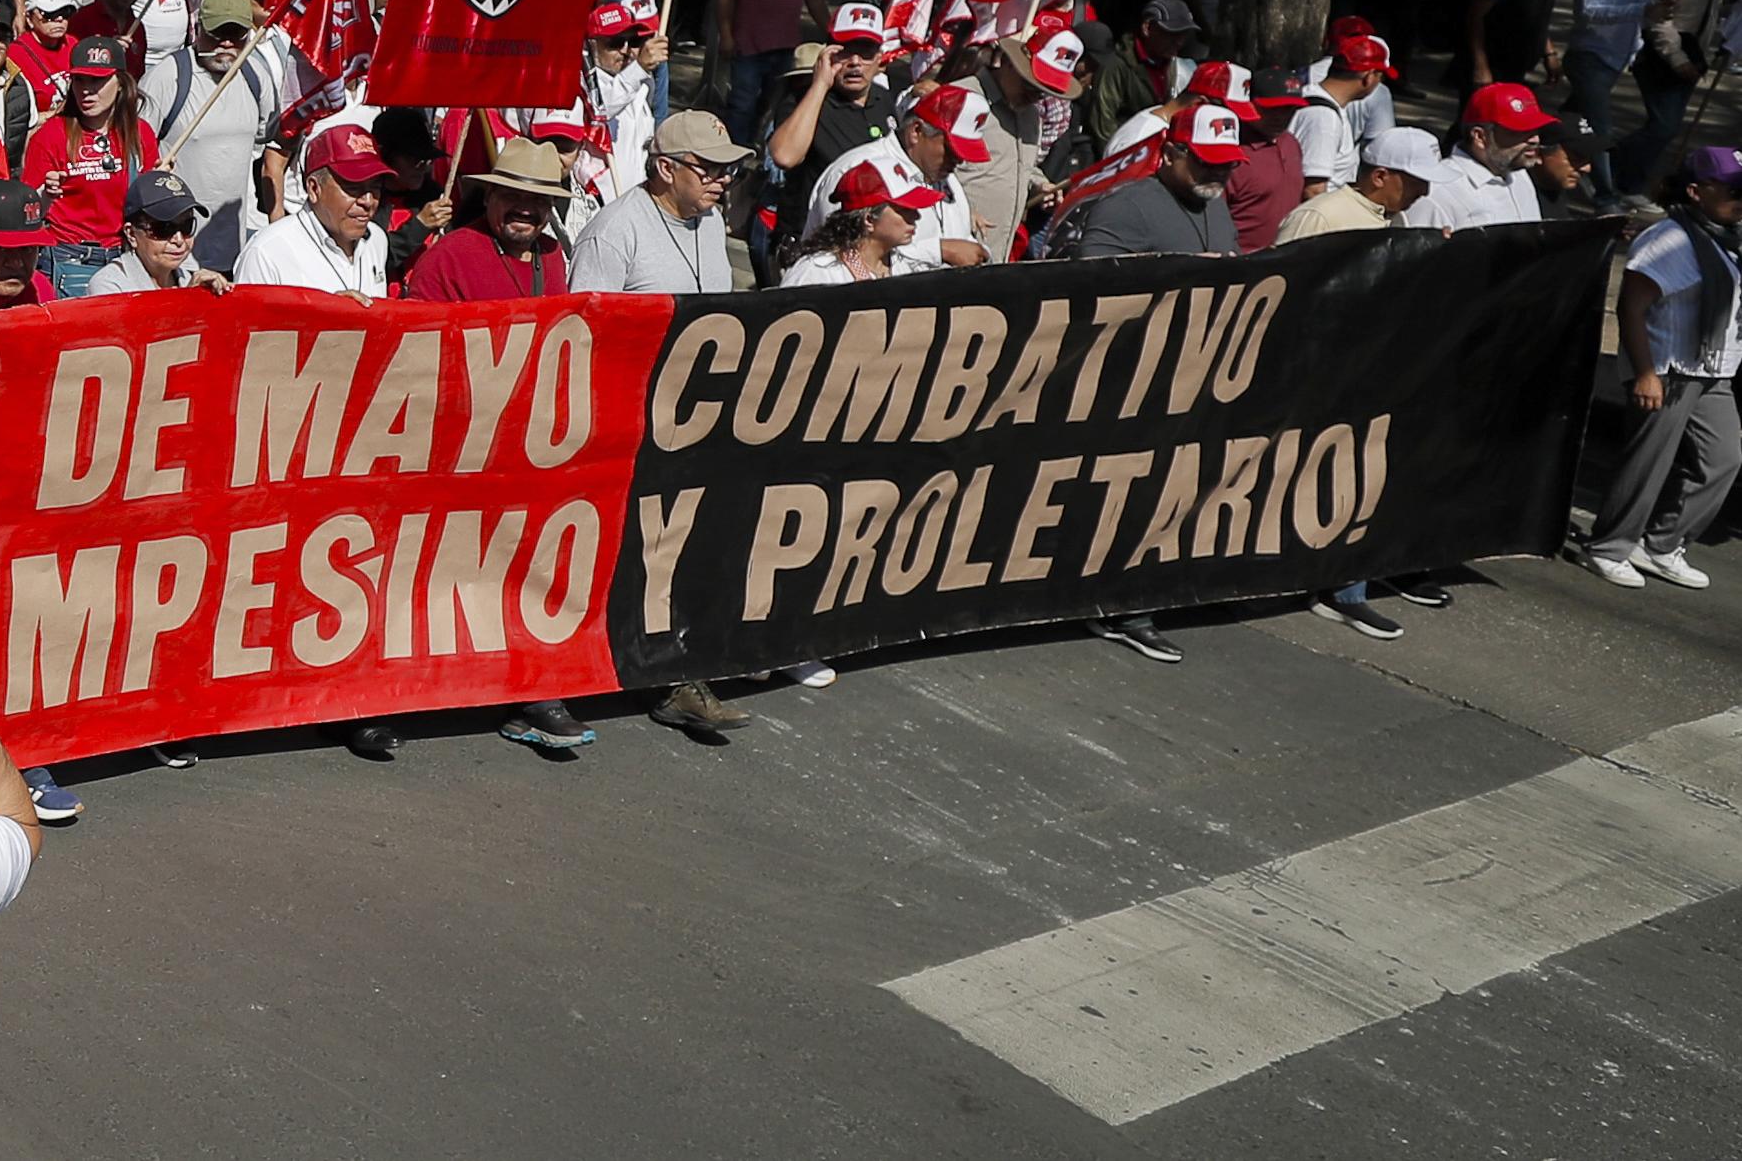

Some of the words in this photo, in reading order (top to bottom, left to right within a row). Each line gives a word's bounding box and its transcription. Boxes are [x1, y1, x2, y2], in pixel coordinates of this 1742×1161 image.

[36, 333, 201, 511] DE
[231, 314, 594, 488] MAYO
[652, 275, 1287, 451] COMBATIVO
[639, 487, 706, 635] Y
[742, 414, 1392, 623] PROLETARIO!
